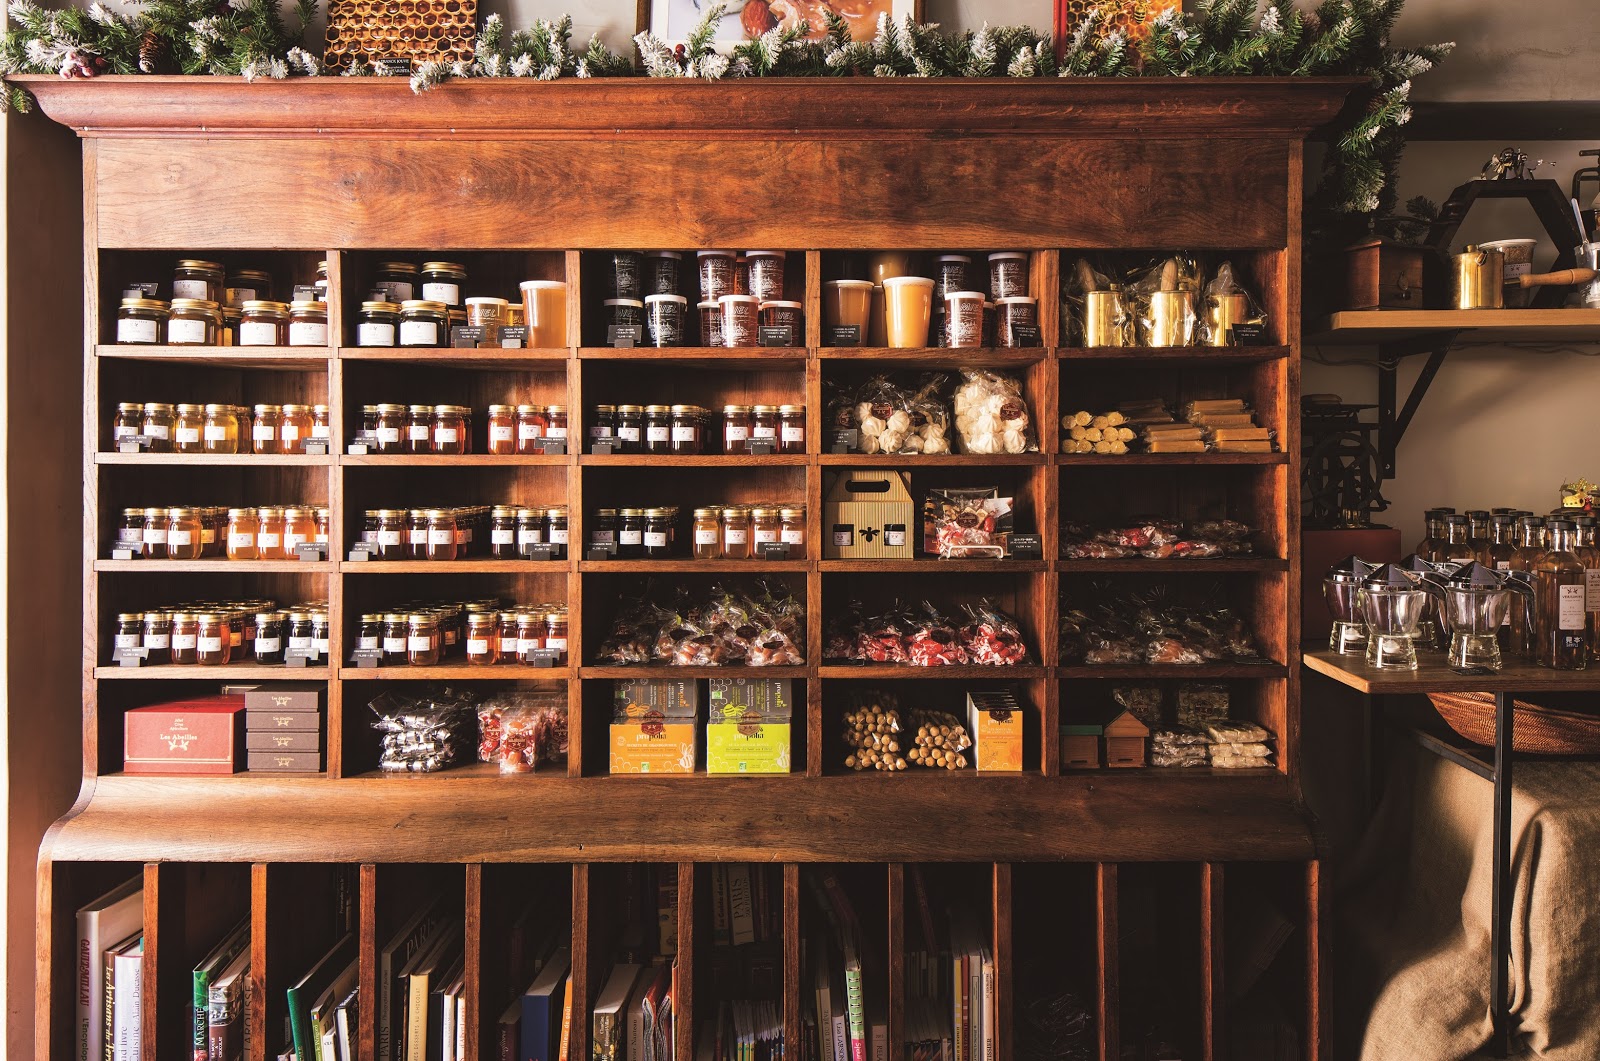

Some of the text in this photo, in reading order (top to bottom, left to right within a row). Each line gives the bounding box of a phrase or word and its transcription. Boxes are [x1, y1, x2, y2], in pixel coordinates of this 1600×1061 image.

[732, 878, 743, 918] PARIS
[106, 982, 115, 1027] Artisans
[106, 1029, 113, 1040] du
[196, 1007, 205, 1046] MARCHÉ
[380, 1026, 389, 1057] PARIS
